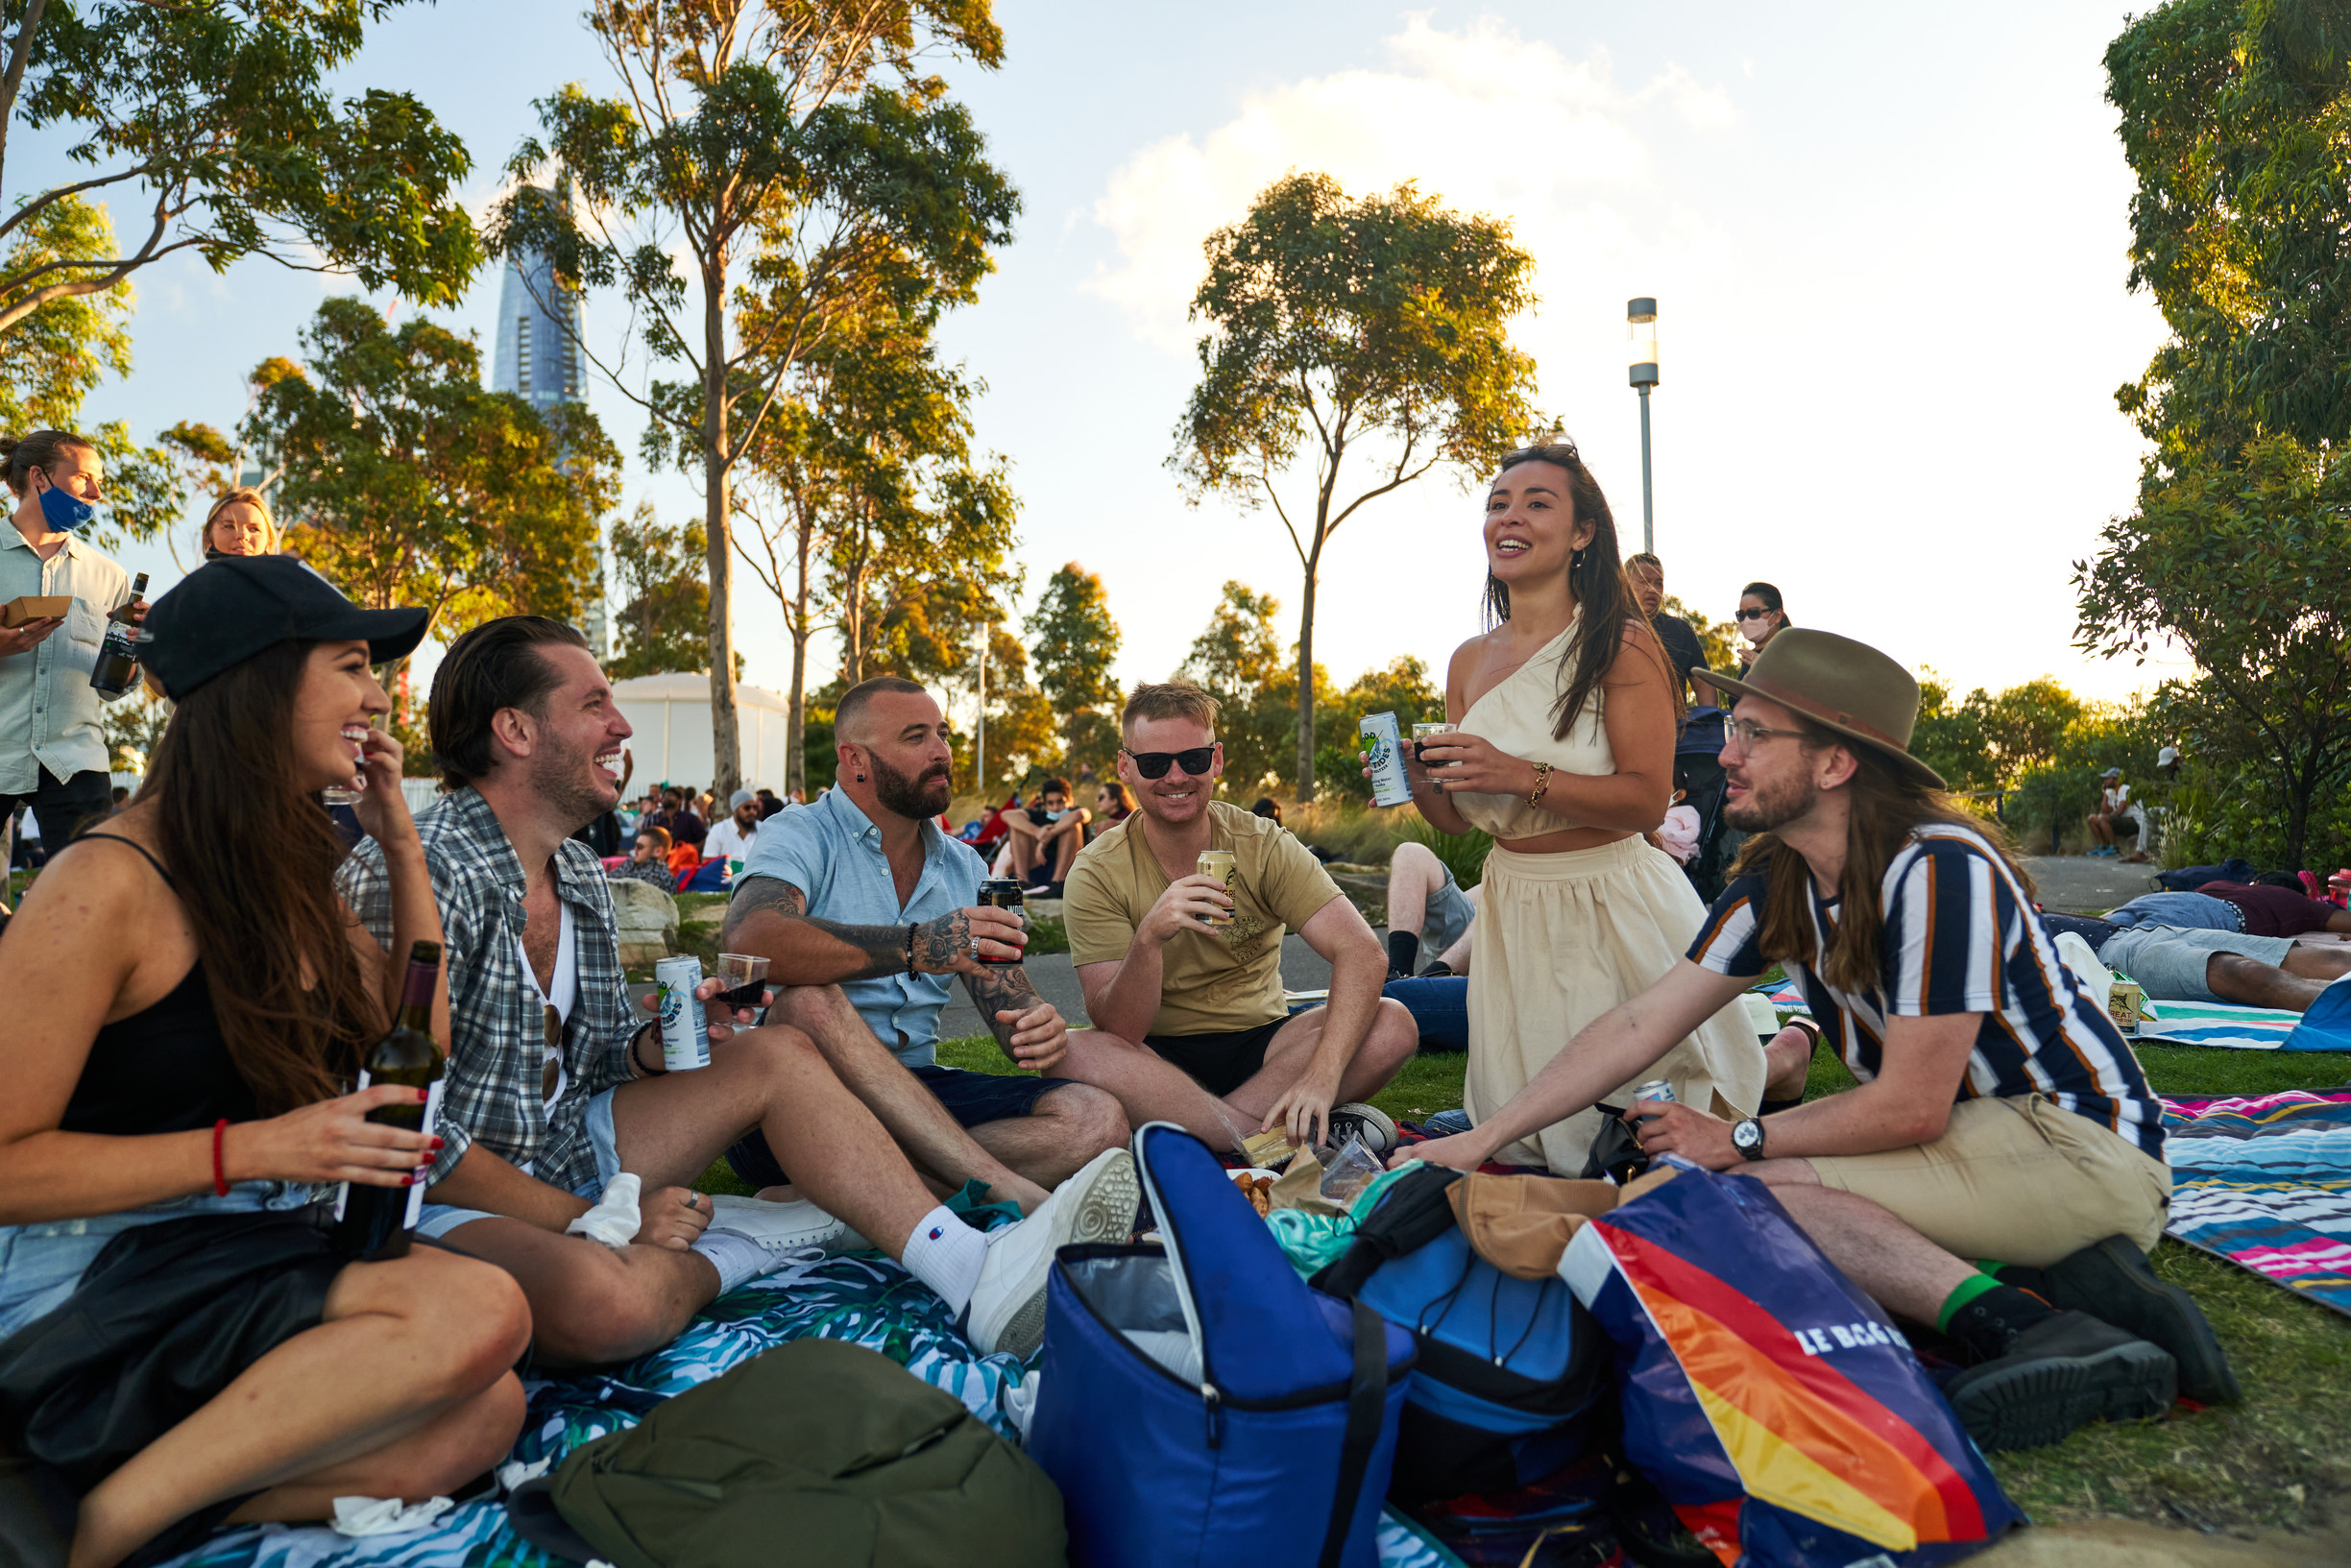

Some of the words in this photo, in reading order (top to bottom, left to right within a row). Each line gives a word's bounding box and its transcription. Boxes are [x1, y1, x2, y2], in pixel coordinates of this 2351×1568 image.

[1372, 748, 1391, 769] TIDES
[1222, 889, 1236, 899] GRE
[1793, 1327, 1833, 1357] LE
